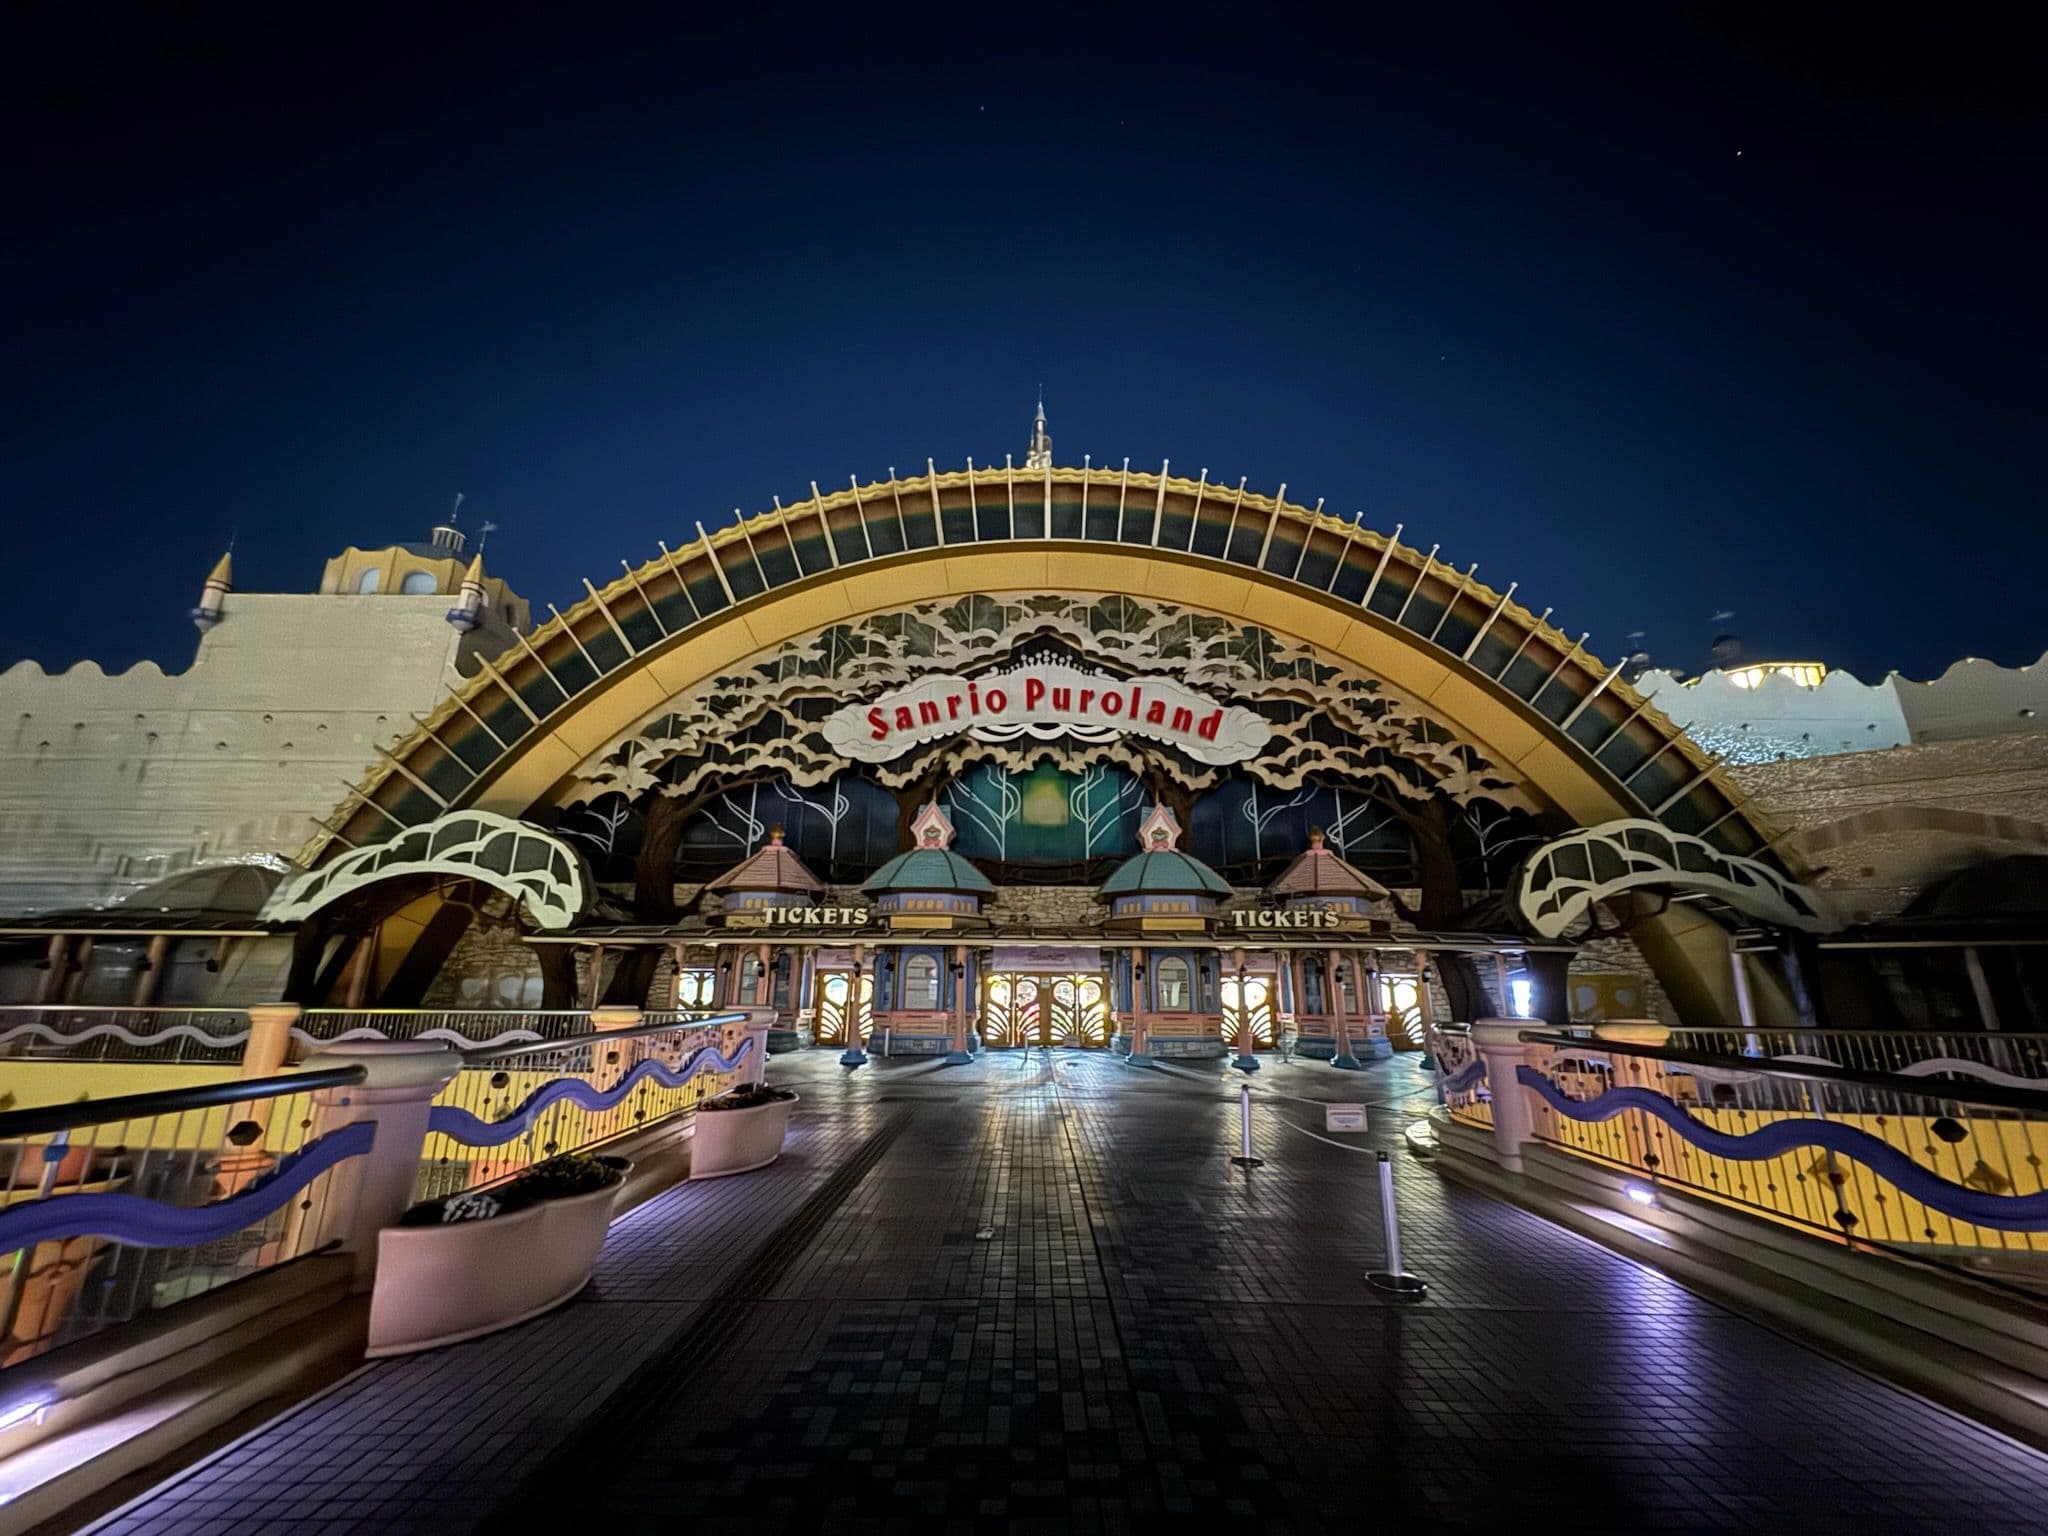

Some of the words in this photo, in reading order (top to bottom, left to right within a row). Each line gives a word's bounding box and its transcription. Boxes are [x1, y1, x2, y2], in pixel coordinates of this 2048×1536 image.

[865, 680, 1008, 742] Sanrio
[1024, 676, 1225, 742] Puroland
[763, 907, 869, 925] TICKETS
[1231, 910, 1340, 928] TICKETS
